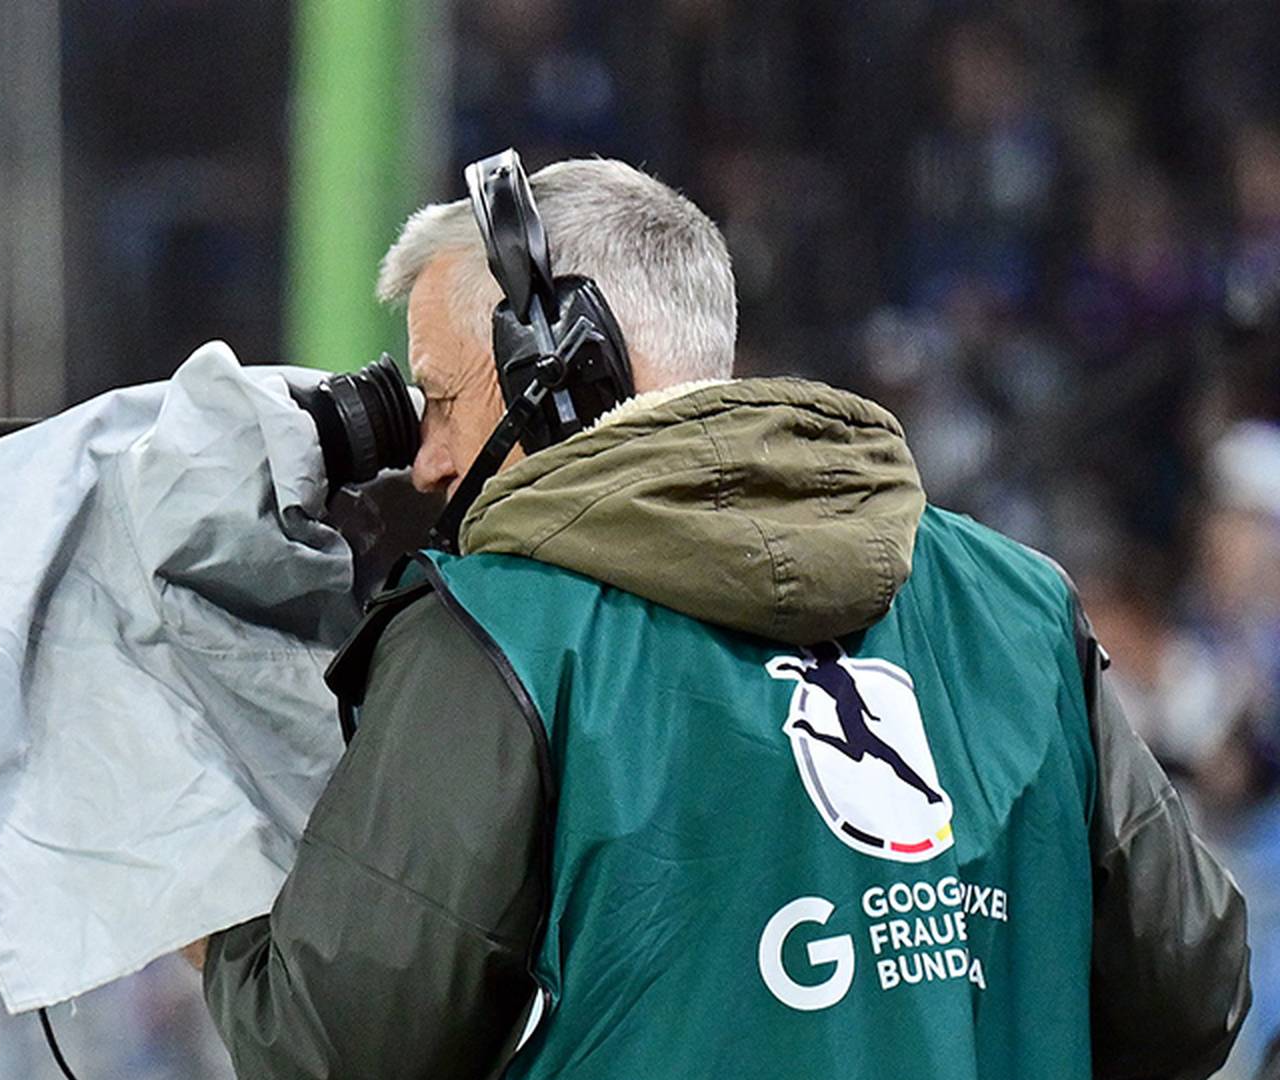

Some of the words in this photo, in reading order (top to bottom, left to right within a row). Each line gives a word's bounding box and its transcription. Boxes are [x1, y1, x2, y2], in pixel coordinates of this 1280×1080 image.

[862, 876, 962, 918] GOOG
[758, 896, 855, 1011] G
[869, 911, 967, 954] FRAUE
[877, 948, 986, 990] BUNDA
